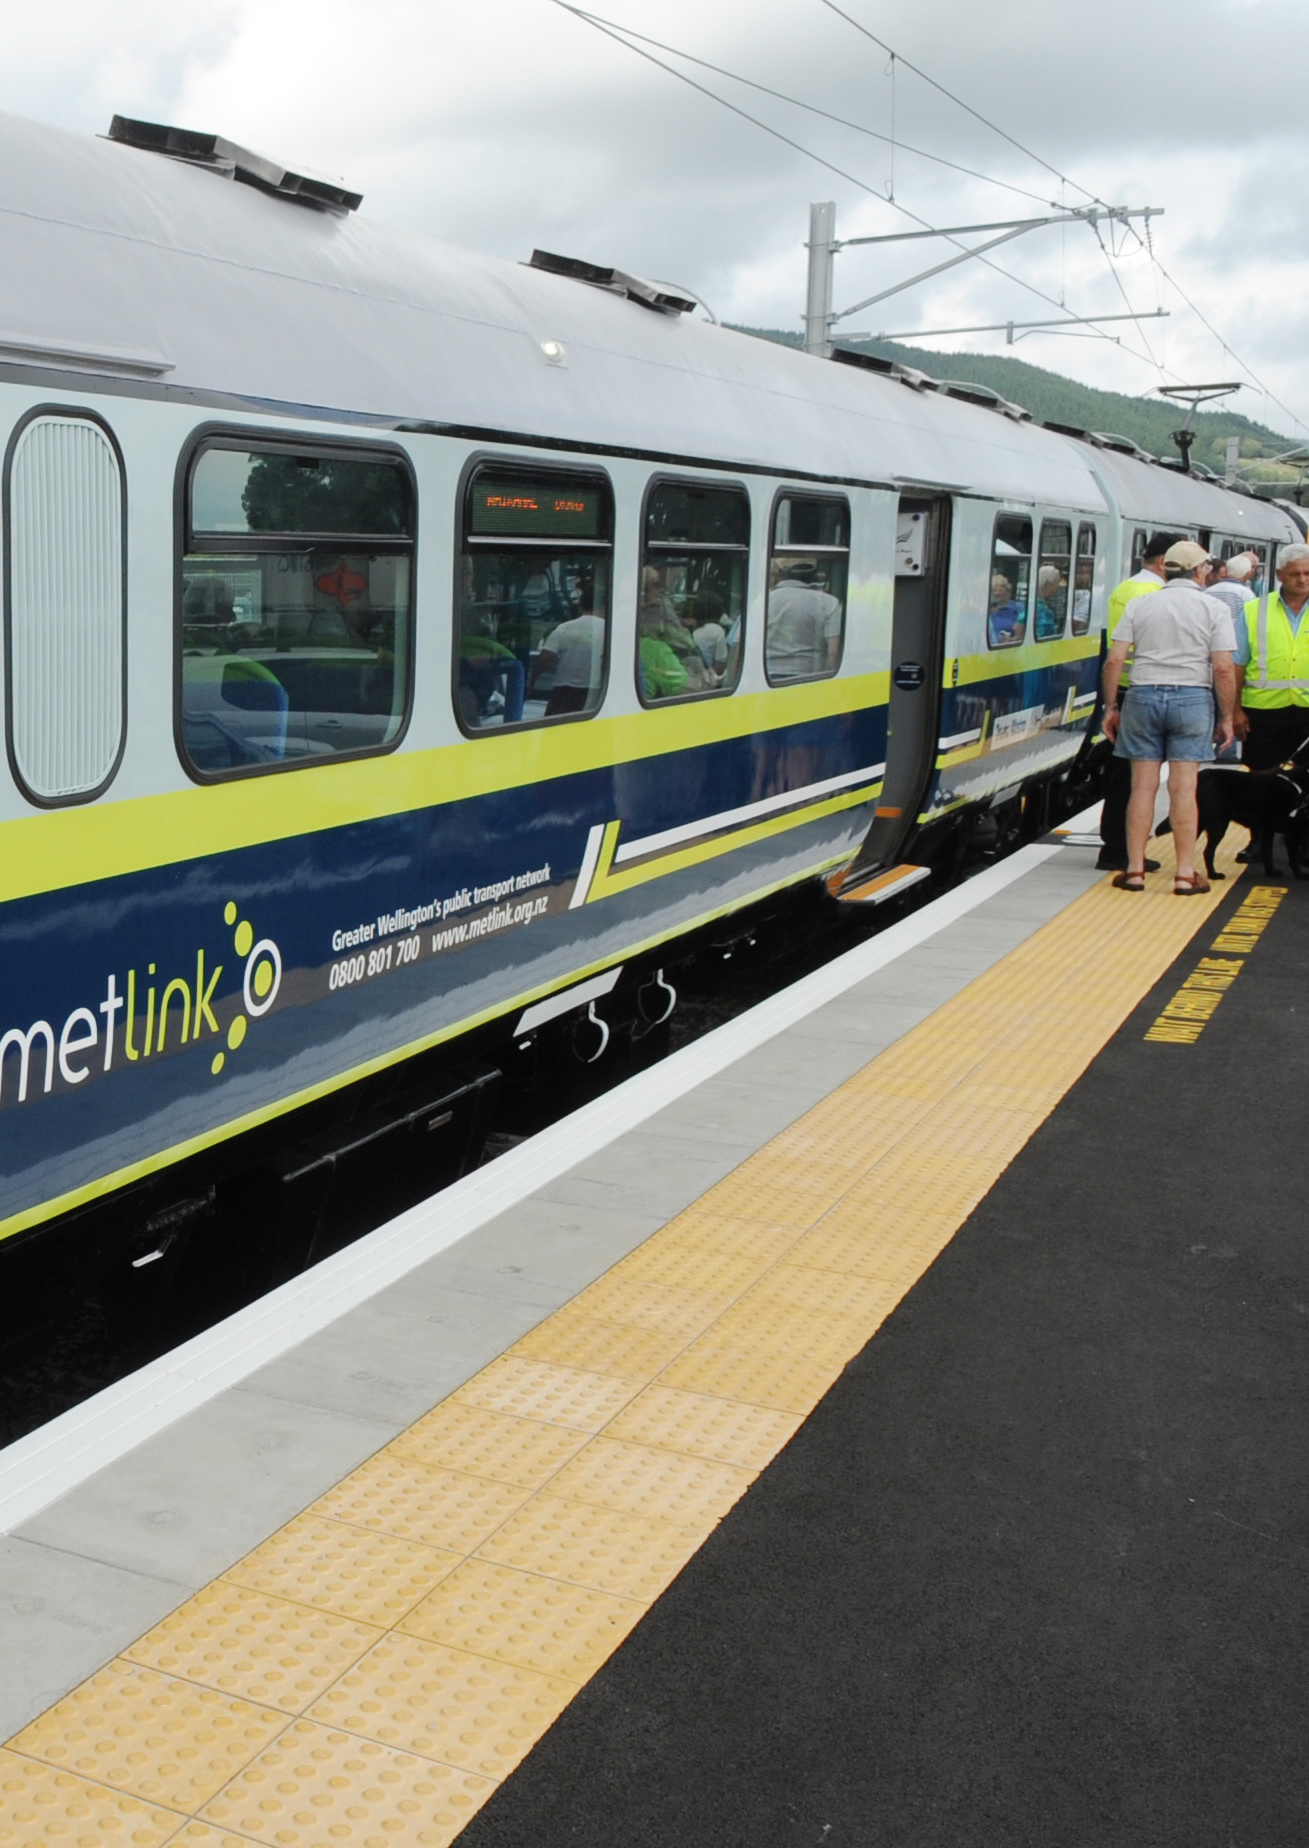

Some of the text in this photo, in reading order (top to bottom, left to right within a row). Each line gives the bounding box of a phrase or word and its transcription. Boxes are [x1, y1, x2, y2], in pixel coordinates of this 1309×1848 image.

[328, 896, 549, 991] 0800 801 700 www.metlink.org.nz
[332, 863, 551, 951] Greater Wellington's public transport network
